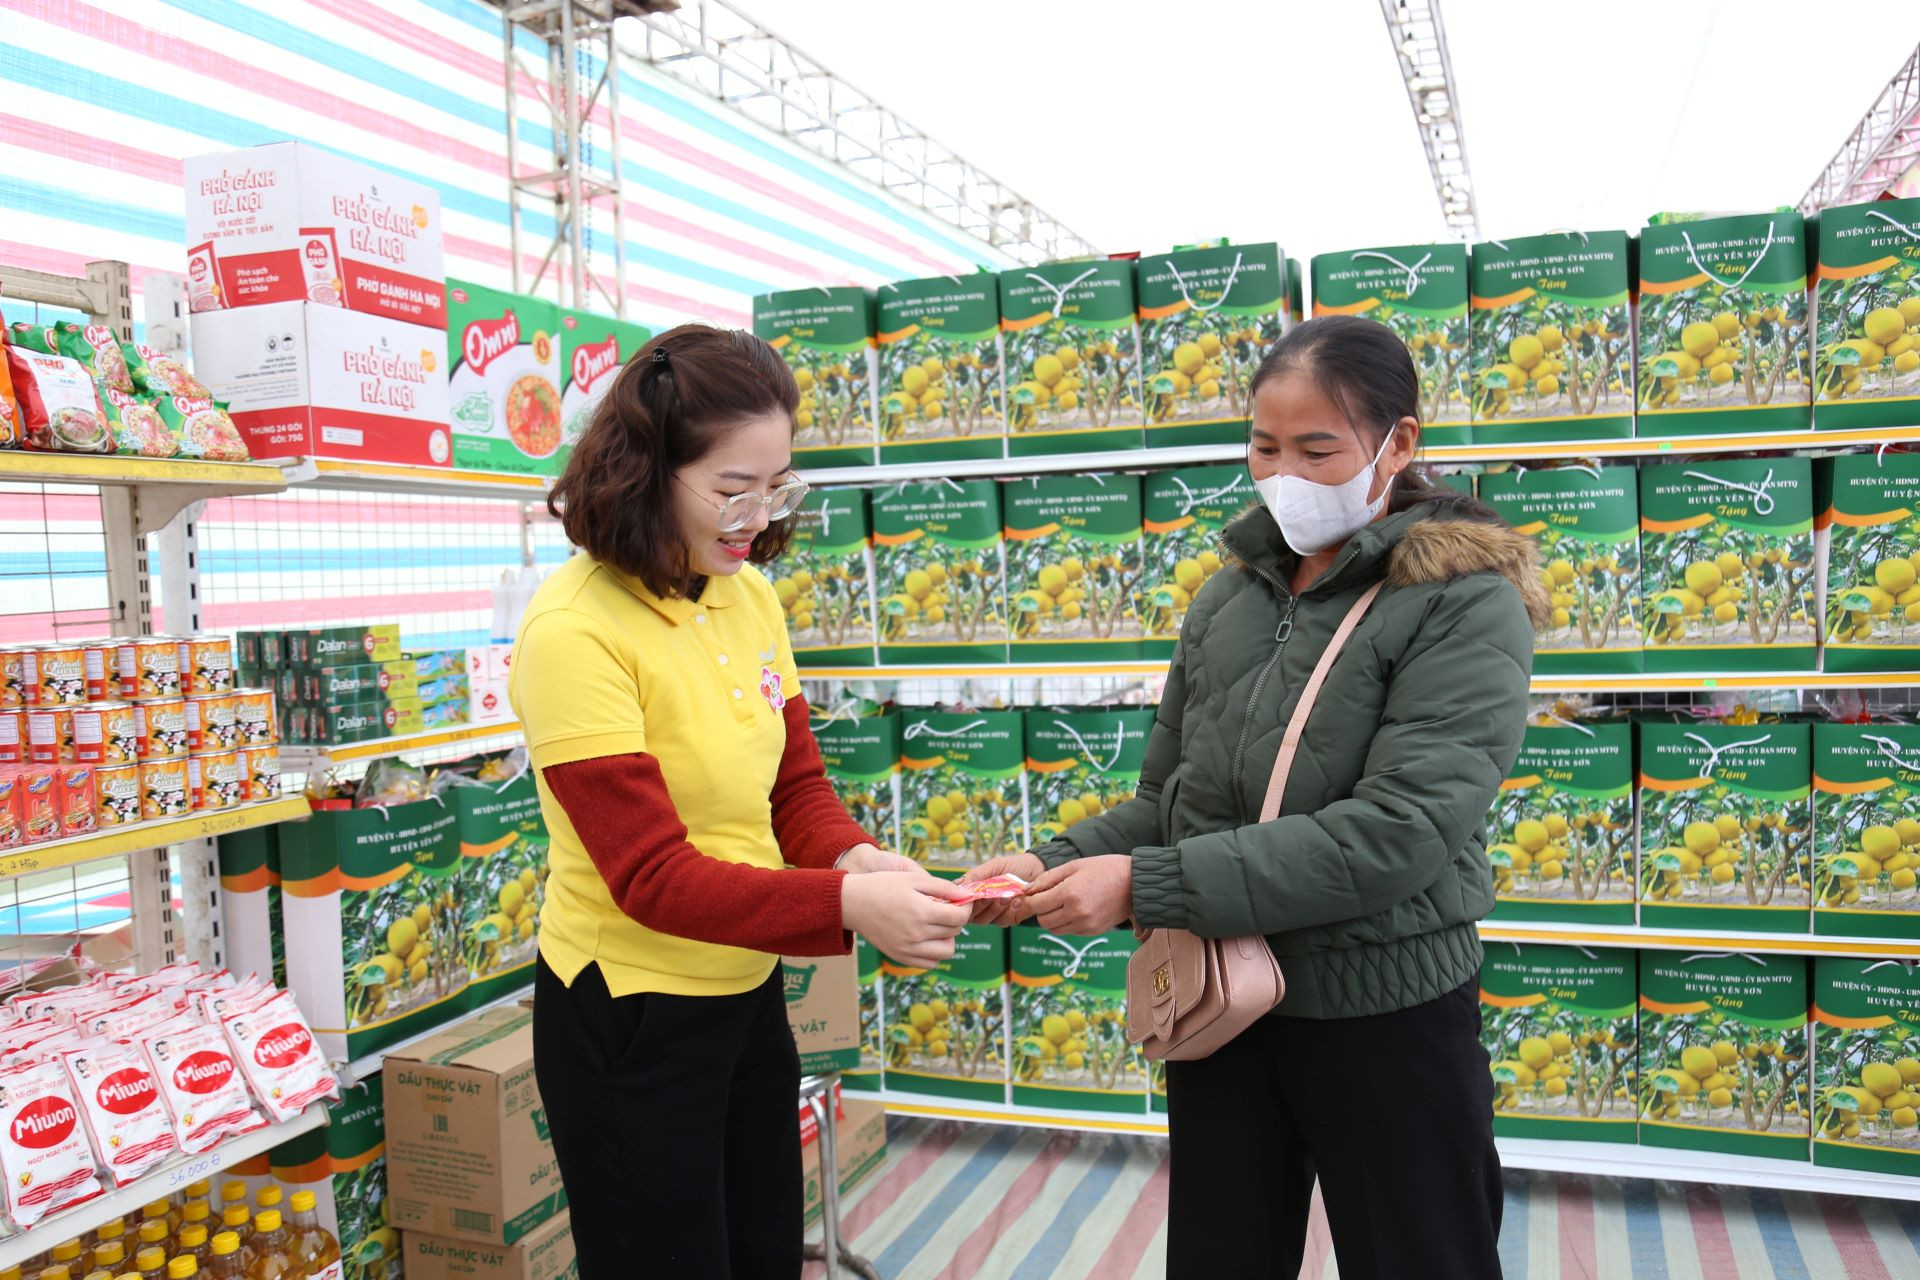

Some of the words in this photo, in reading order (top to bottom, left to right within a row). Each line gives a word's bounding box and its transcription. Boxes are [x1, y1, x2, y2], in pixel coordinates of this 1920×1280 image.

[233, 169, 276, 190] GÁNH
[333, 193, 370, 224] PHỞ
[372, 205, 418, 238] GÁNH
[350, 225, 376, 255] HÀ
[379, 236, 408, 265] NỘI
[344, 346, 381, 377] PHỞ
[382, 348, 428, 384] GÁNH
[361, 378, 387, 404] HÀ
[388, 382, 416, 411] NỘI
[316, 638, 347, 653] Dalan
[364, 636, 374, 648] 6
[330, 678, 360, 692] Dalan
[380, 674, 389, 686] 6
[337, 716, 368, 730] Dalan
[386, 712, 396, 725] 6
[1685, 983, 1718, 994] HUYỆN
[1721, 984, 1740, 995] YÊN
[1744, 986, 1762, 995] SƠN
[1867, 996, 1902, 1008] HUYỆN
[800, 1019, 828, 1036] VẬT
[256, 1030, 310, 1064] Miwon
[175, 1060, 232, 1088] Miwon
[398, 1070, 422, 1087] DẦU
[424, 1077, 456, 1094] THỰC
[458, 1080, 482, 1096] VẬT
[15, 1106, 75, 1140] Miwon
[169, 1160, 208, 1186] 36.000
[418, 1240, 444, 1257] DẦU
[448, 1247, 478, 1264] THỰC
[480, 1252, 505, 1269] VẬT
